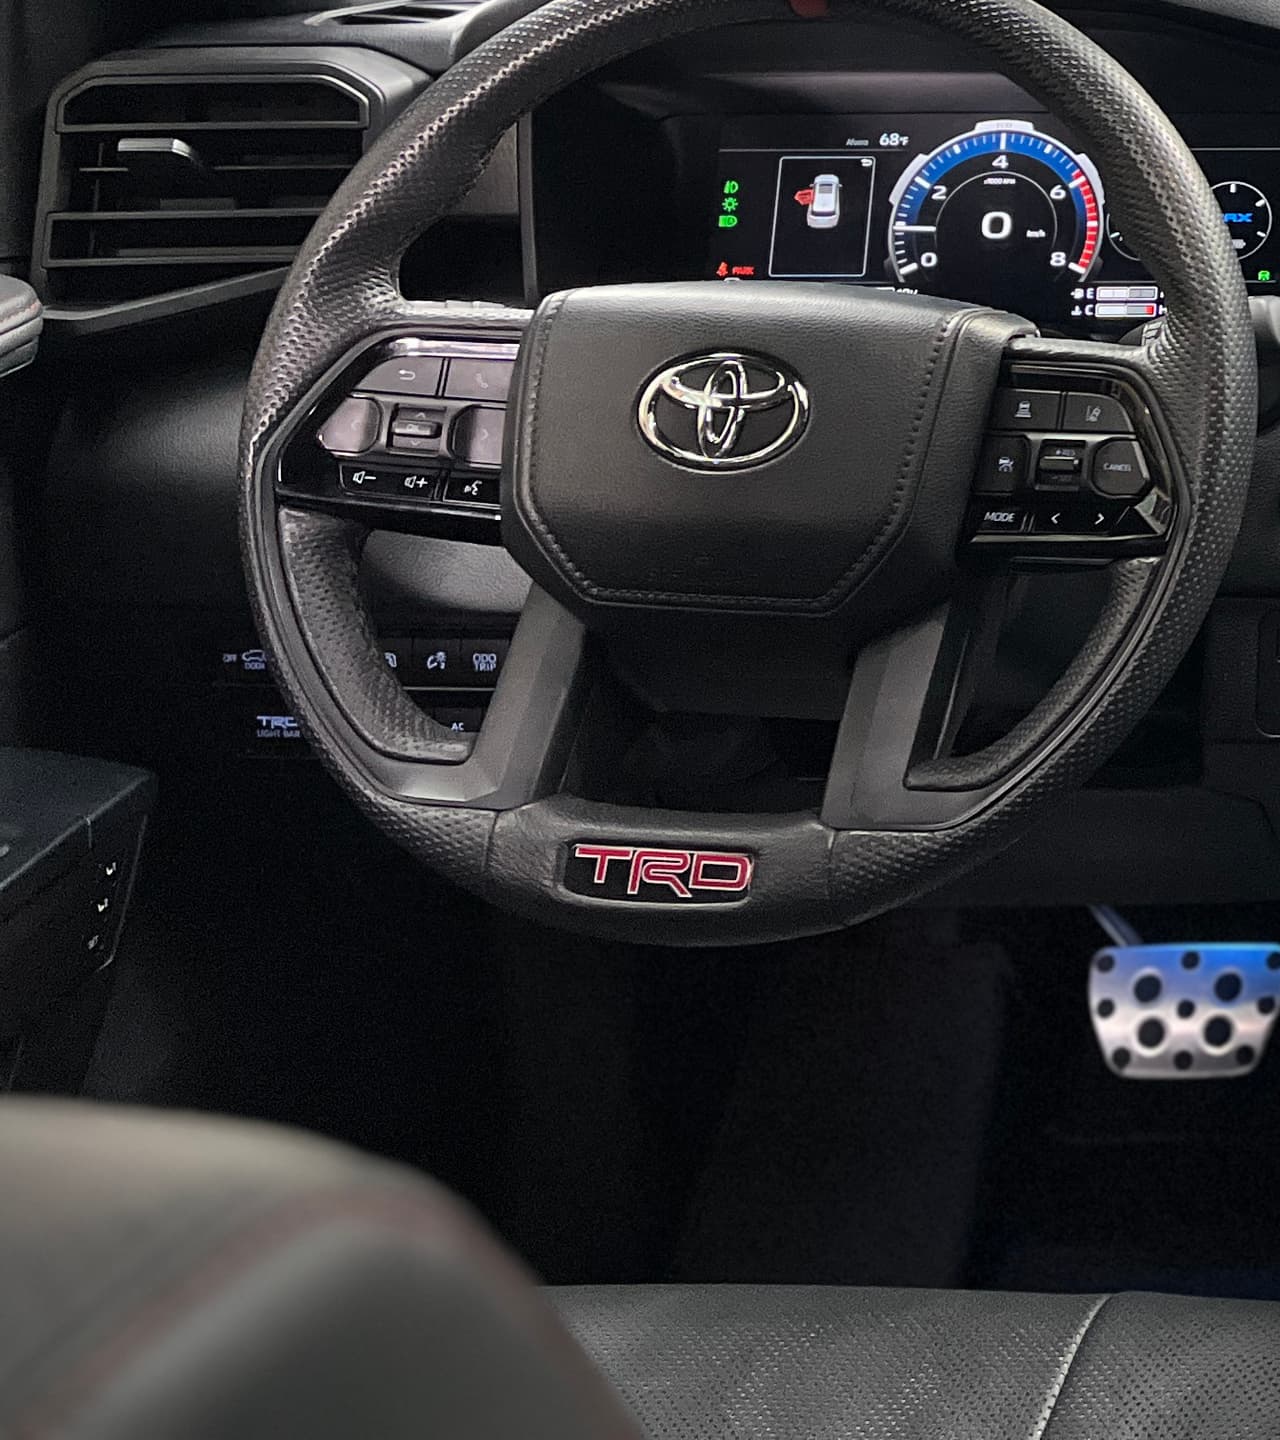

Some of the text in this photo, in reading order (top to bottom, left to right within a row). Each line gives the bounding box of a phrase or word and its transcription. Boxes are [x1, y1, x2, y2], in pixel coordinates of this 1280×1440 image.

[992, 155, 1009, 169] 4
[931, 185, 947, 200] 2
[1050, 185, 1066, 199] 6
[981, 211, 1012, 240] 0
[920, 252, 937, 267] 0
[1050, 252, 1066, 267] 8
[1086, 288, 1095, 299] E
[1085, 304, 1094, 316] C
[984, 511, 1016, 523] MODE
[472, 653, 497, 664] ODO
[474, 662, 496, 672] TRIP
[451, 722, 465, 732] AC
[574, 843, 753, 898] TRD
